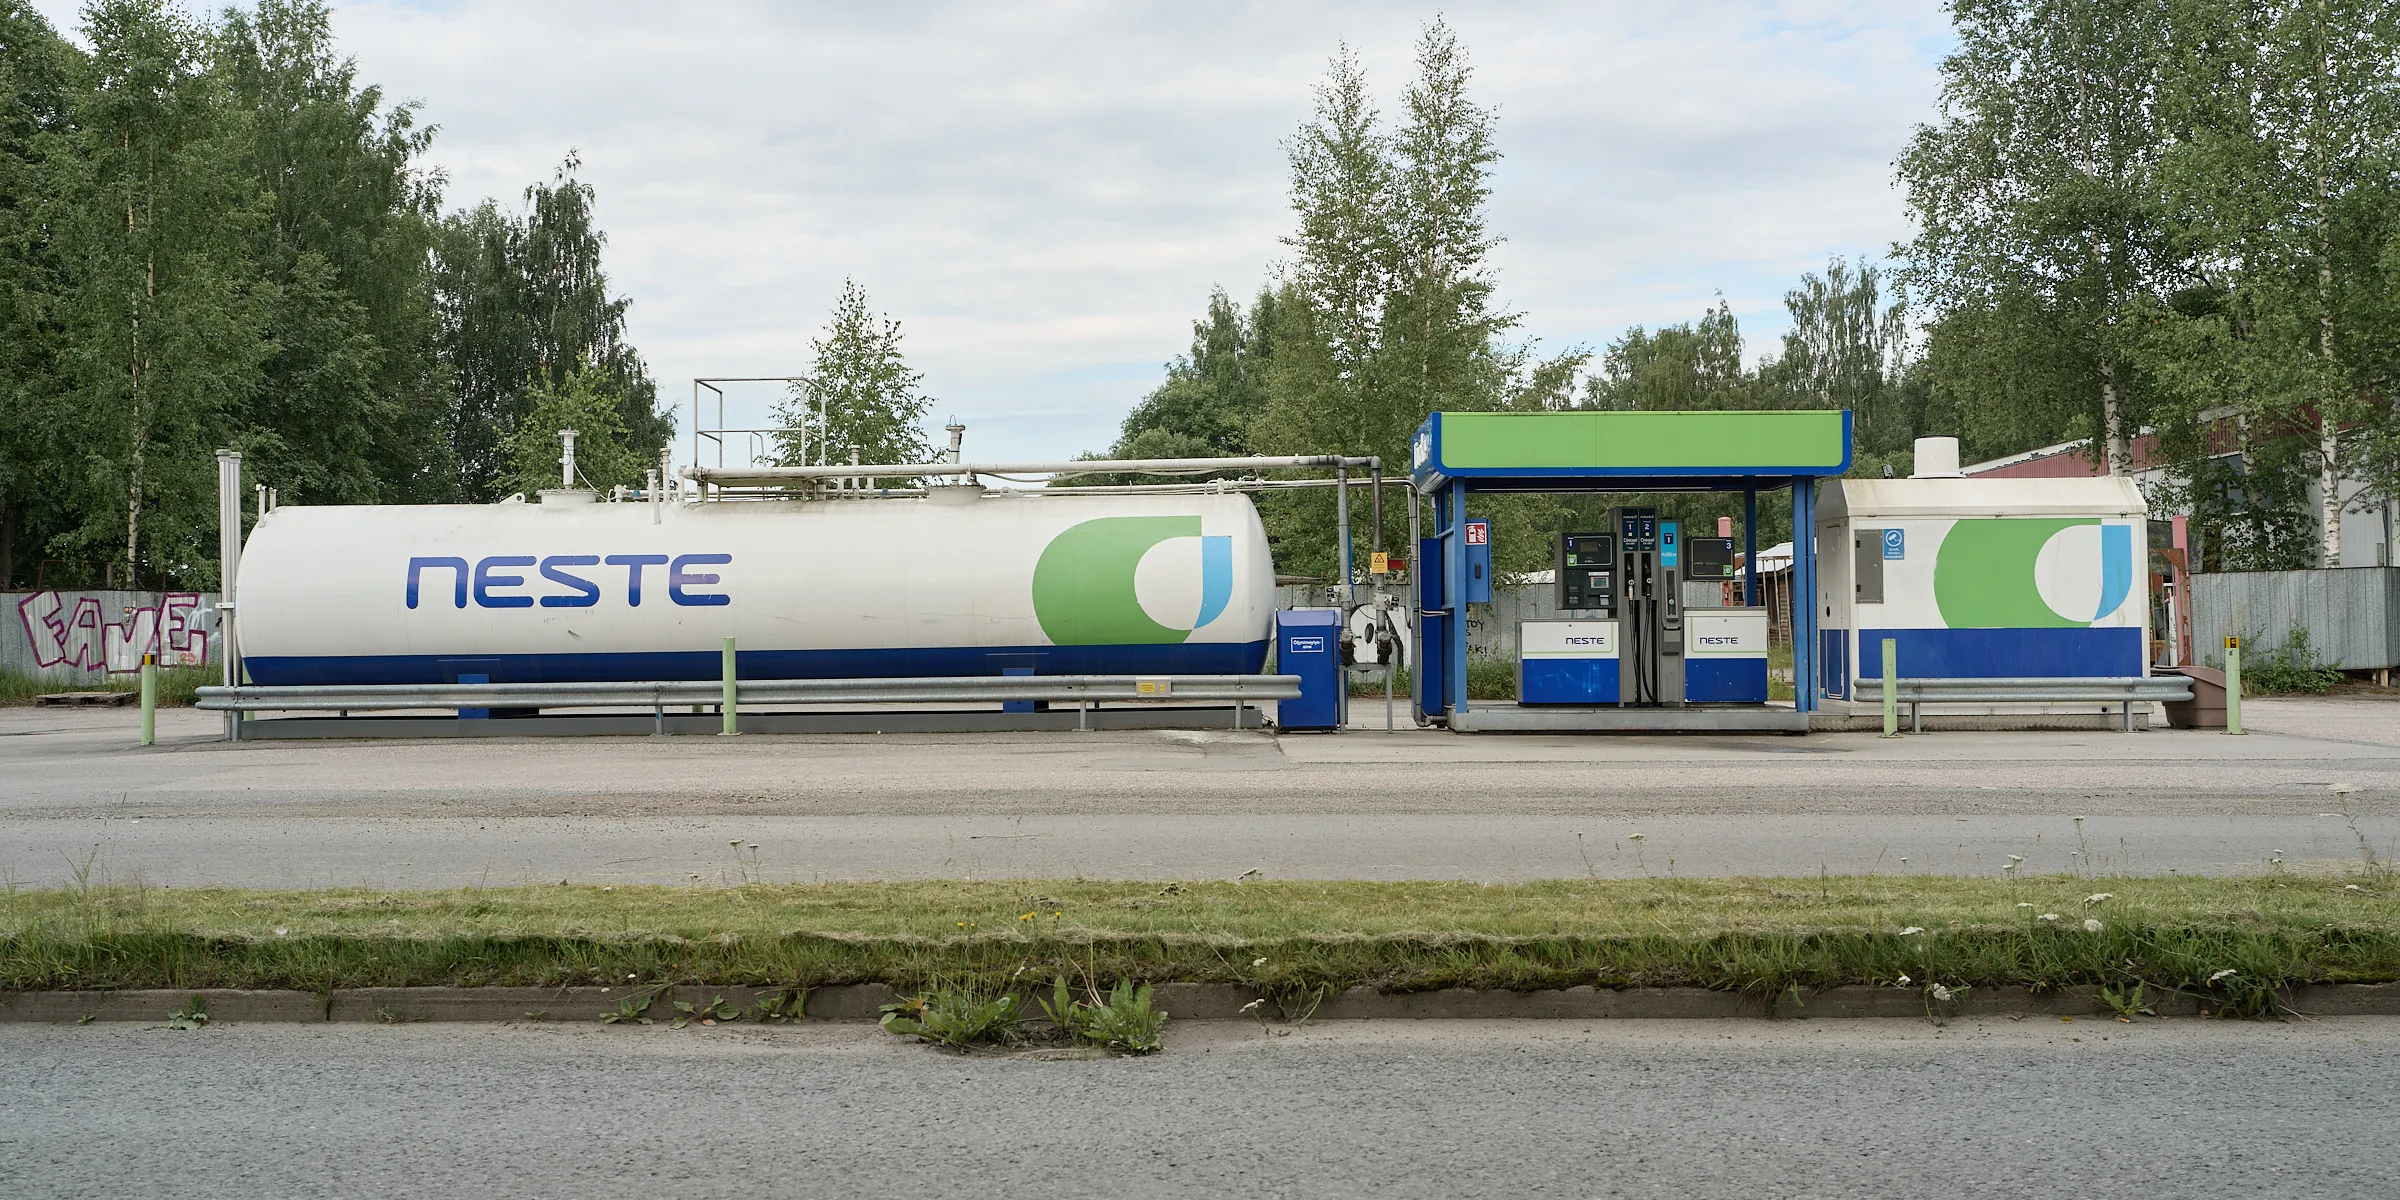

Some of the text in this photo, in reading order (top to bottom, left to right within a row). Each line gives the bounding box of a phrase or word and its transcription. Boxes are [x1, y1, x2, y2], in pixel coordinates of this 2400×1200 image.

[1568, 539, 1573, 547] 1
[406, 553, 733, 609] NESTE
[1565, 637, 1604, 645] NESTE
[1699, 637, 1738, 645] NESTE
